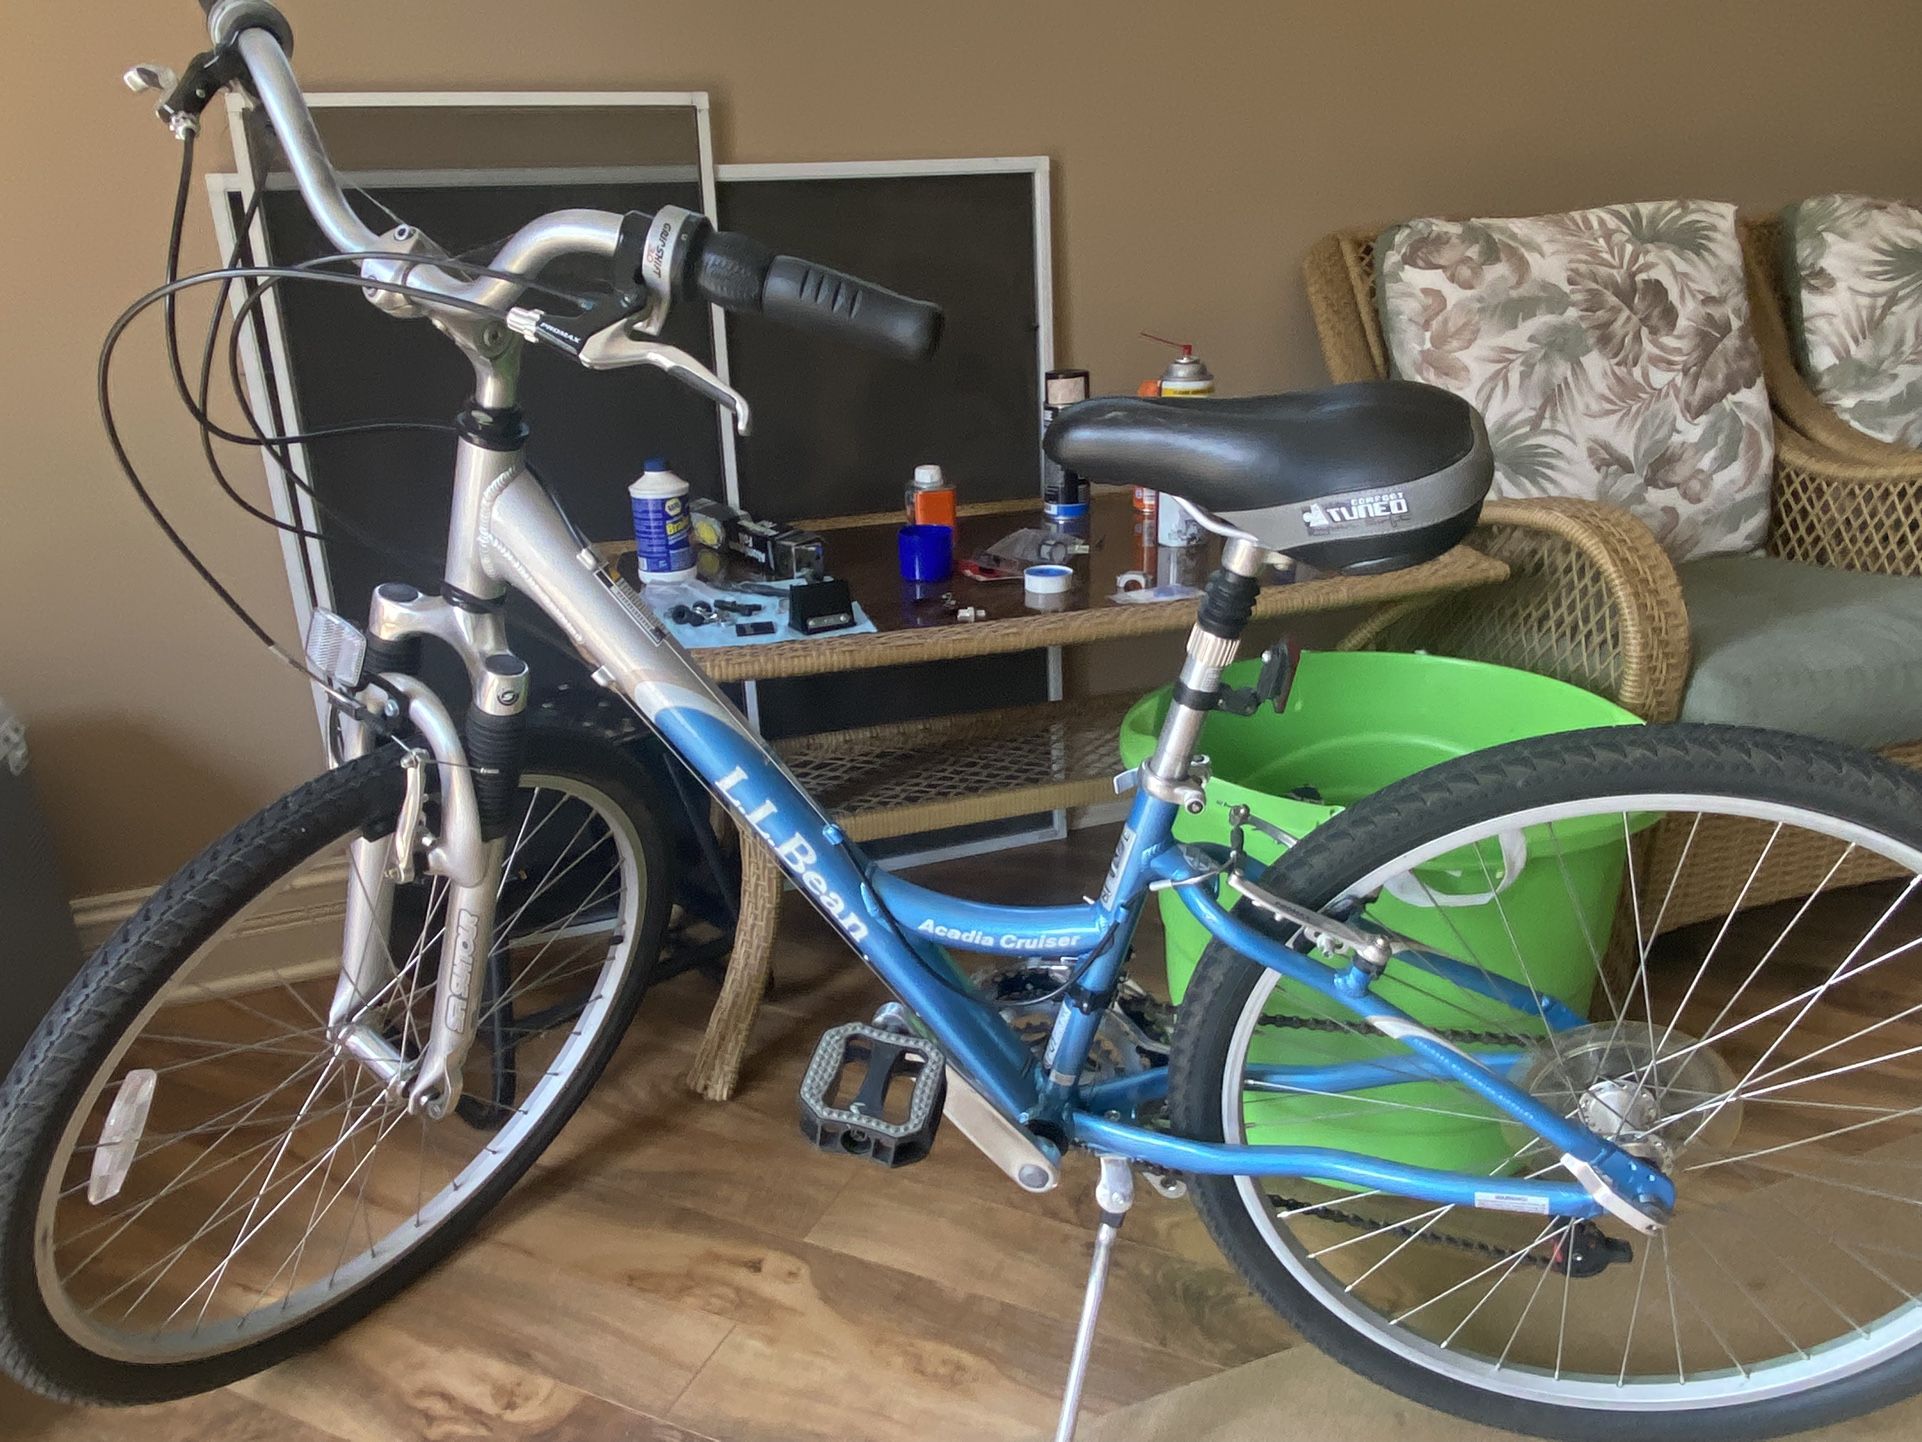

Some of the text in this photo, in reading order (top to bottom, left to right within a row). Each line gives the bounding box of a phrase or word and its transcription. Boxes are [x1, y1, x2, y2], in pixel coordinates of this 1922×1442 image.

[540, 322, 581, 344] PROMAX
[1326, 499, 1409, 522] TUNED
[1350, 492, 1404, 506] COMFORT
[918, 918, 1081, 949] Acadia Cruiser
[449, 908, 480, 1000] SUNTOUR
